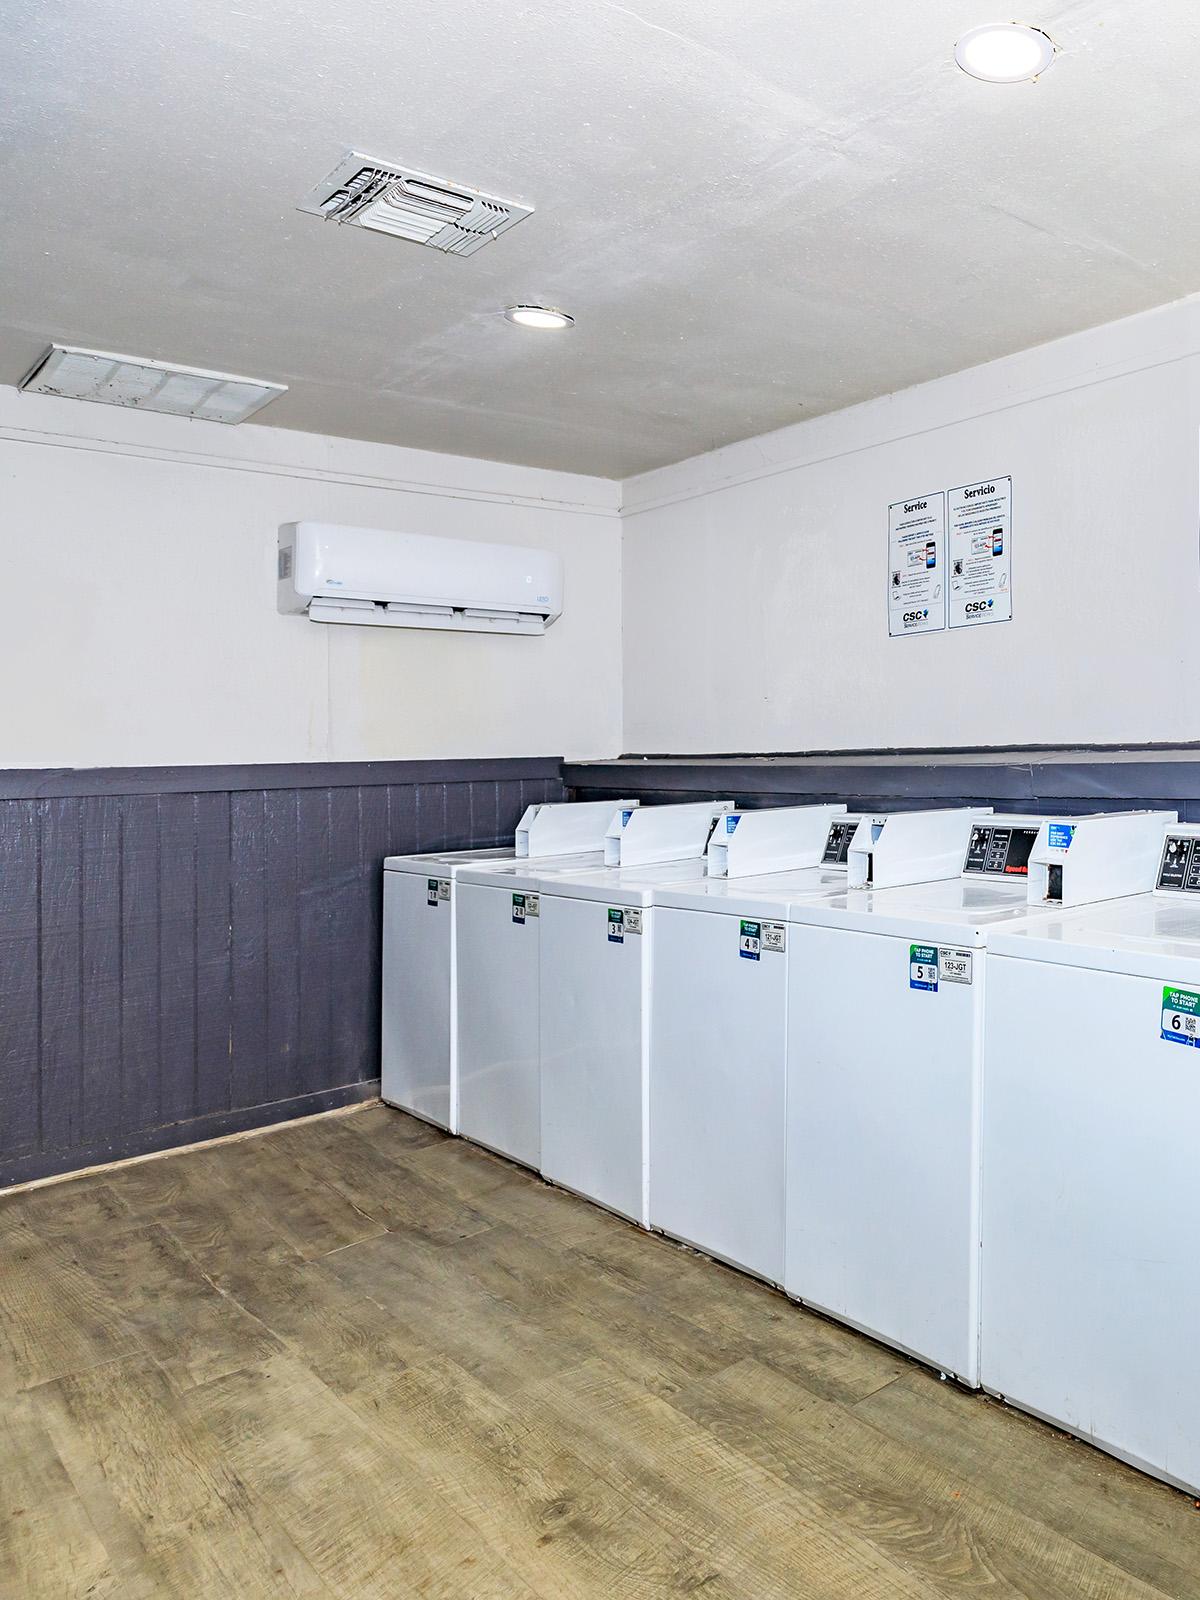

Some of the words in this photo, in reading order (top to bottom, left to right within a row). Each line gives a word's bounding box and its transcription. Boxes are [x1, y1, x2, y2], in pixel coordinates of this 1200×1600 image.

[964, 484, 995, 499] Servicio
[903, 500, 928, 514] Service
[965, 601, 987, 613] CSC
[903, 610, 922, 622] CSC
[515, 907, 519, 916] 2
[611, 923, 616, 934] 3
[744, 938, 750, 950] 4
[917, 965, 924, 979] 5
[944, 961, 967, 971] 123-JGT
[1179, 999, 1196, 1008] START
[1180, 994, 1199, 1003] PHONE
[1171, 1014, 1181, 1030] 6
